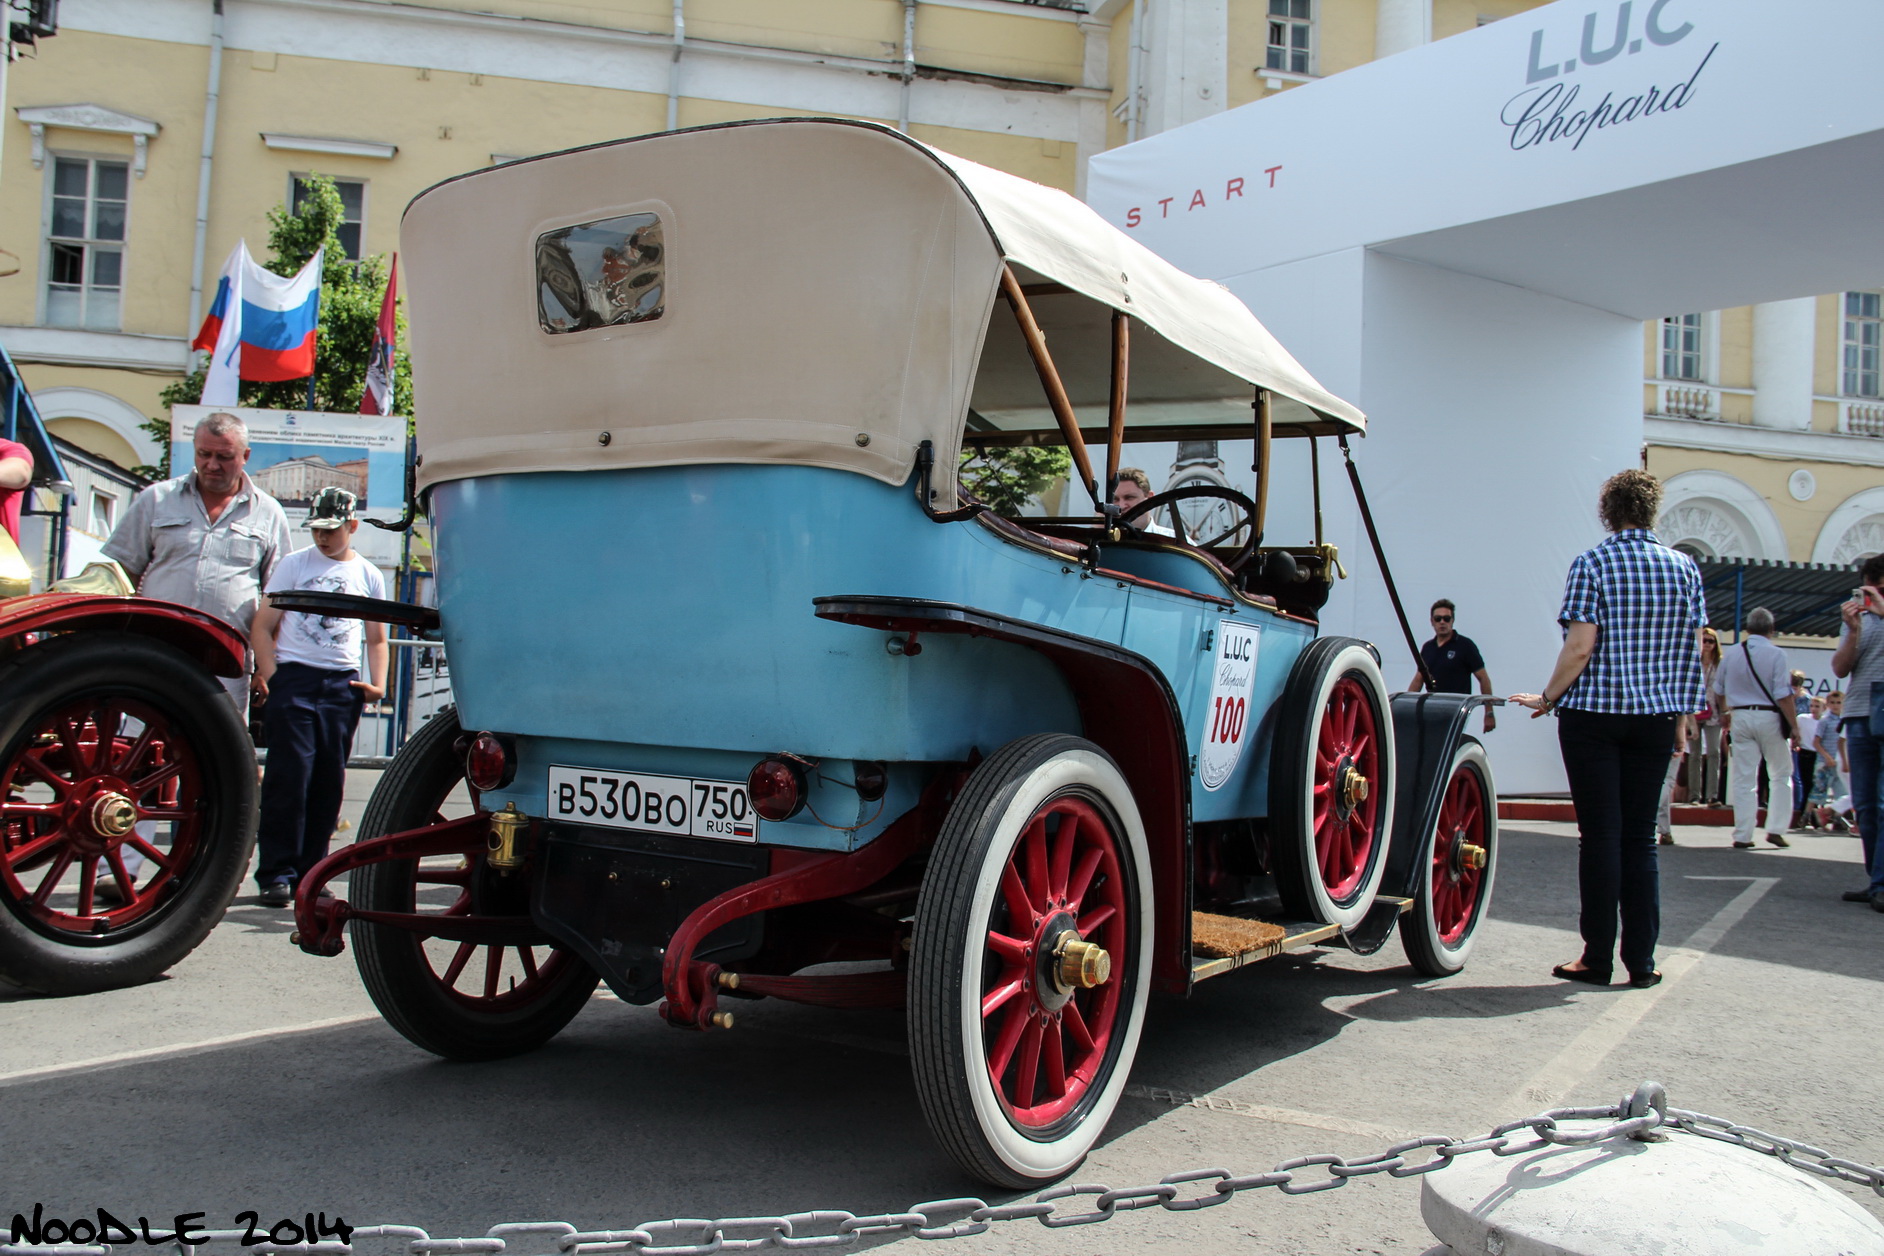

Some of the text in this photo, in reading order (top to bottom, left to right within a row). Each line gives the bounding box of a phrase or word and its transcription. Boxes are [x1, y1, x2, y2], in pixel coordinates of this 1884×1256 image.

[1526, 0, 1695, 85] L.U.C
[1501, 42, 1720, 151] Chopard
[1126, 165, 1283, 228] START
[1223, 635, 1252, 662] L.U.C
[1219, 662, 1250, 692] Chopard
[1210, 696, 1245, 744] 100
[694, 784, 747, 821] 750
[706, 820, 733, 835] RUS
